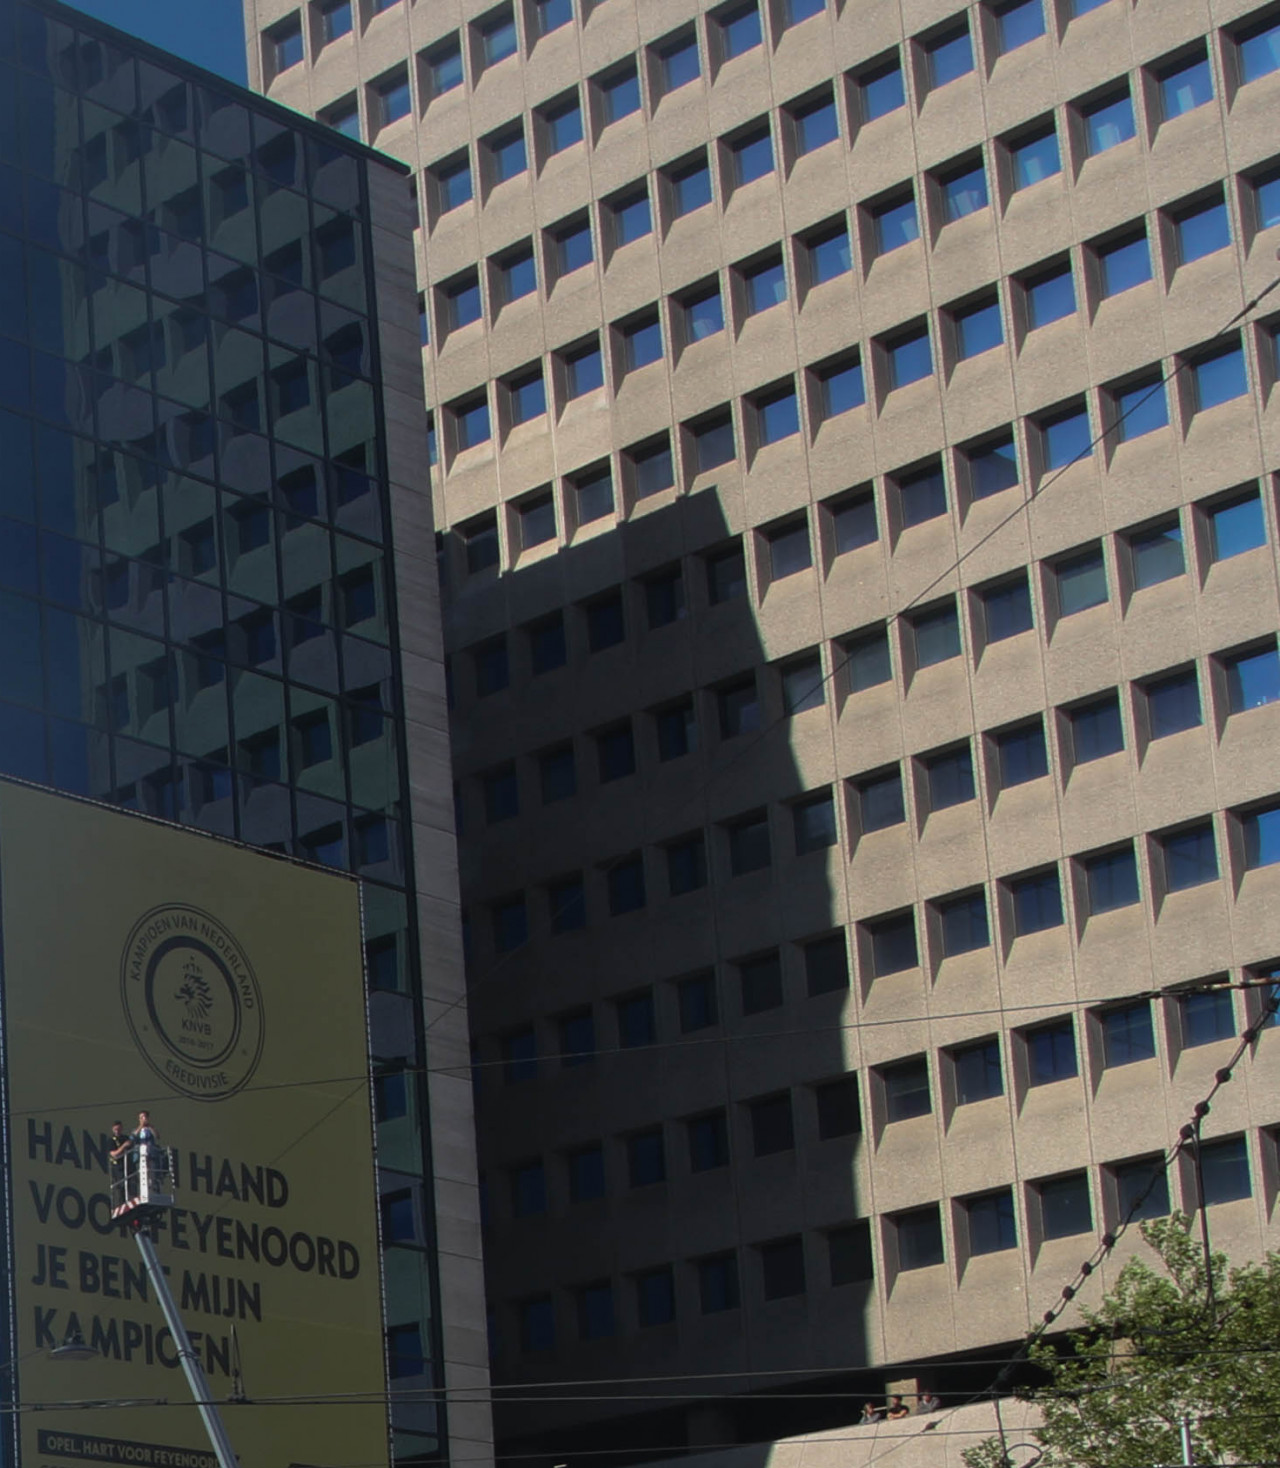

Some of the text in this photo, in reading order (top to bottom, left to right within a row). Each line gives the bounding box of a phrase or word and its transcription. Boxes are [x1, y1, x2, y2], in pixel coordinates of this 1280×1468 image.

[130, 915, 254, 1010] KAMPIOEN VAN NEDERLAND
[182, 1017, 212, 1036] KNVB
[166, 1059, 230, 1089] EREDIVISIE
[28, 1118, 109, 1174] HAN
[190, 1151, 289, 1208] HAND
[32, 1244, 69, 1289] JE
[182, 1270, 262, 1323] MIJN
[83, 1440, 116, 1457] HART
[117, 1444, 152, 1463] VOOR
